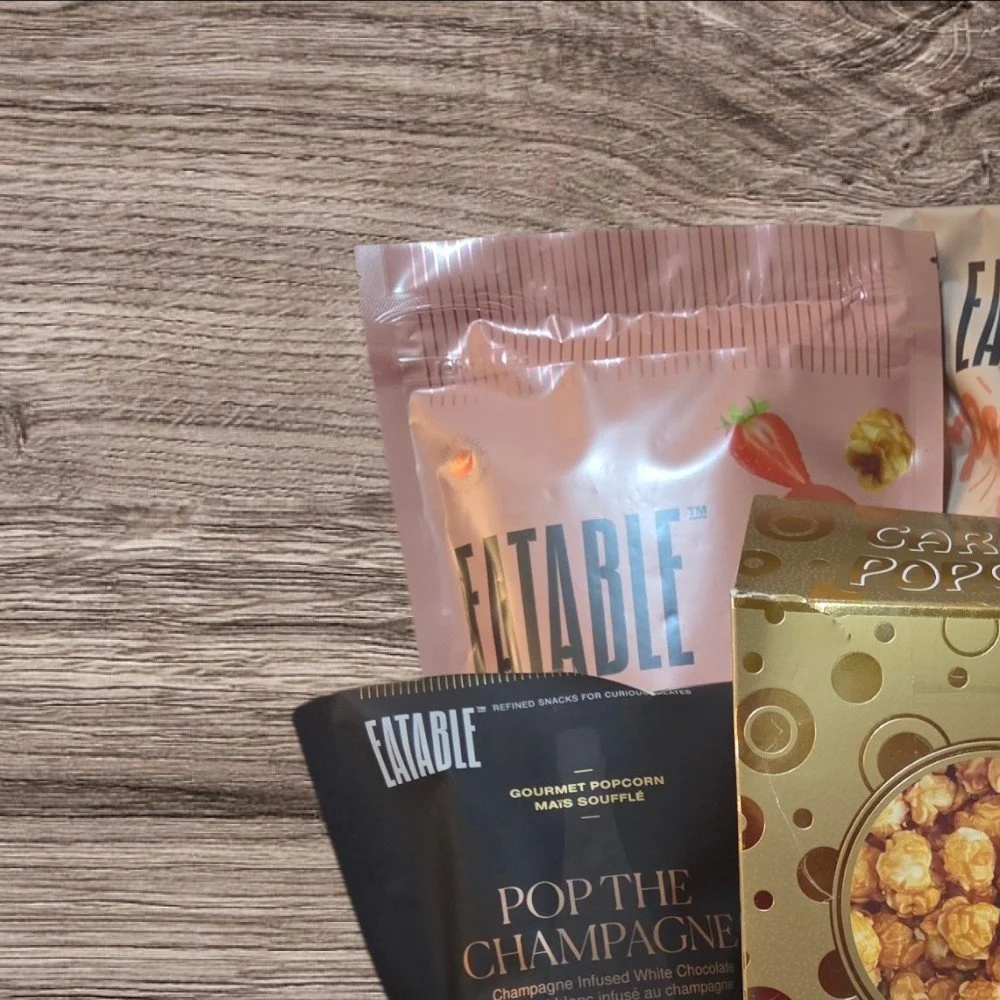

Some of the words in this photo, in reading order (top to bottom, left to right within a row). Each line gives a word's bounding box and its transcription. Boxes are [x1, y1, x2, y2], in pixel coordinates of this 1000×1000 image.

[454, 508, 695, 676] EATABLE
[492, 700, 535, 712] REFINED
[538, 694, 579, 707] SNACKS
[581, 691, 602, 701] FOR
[365, 707, 482, 788] EATABLE
[509, 782, 587, 798] GOURMET
[590, 776, 665, 791] POPCORN
[577, 790, 645, 807] SOUFFLÉ
[497, 878, 593, 925] POP
[600, 869, 692, 911] THE
[463, 914, 738, 980] CHAMPAGNE
[578, 973, 630, 988] Infused
[633, 967, 672, 981] White
[676, 961, 734, 977] Chocolate
[644, 988, 661, 998] au
[665, 980, 734, 997] champagne
